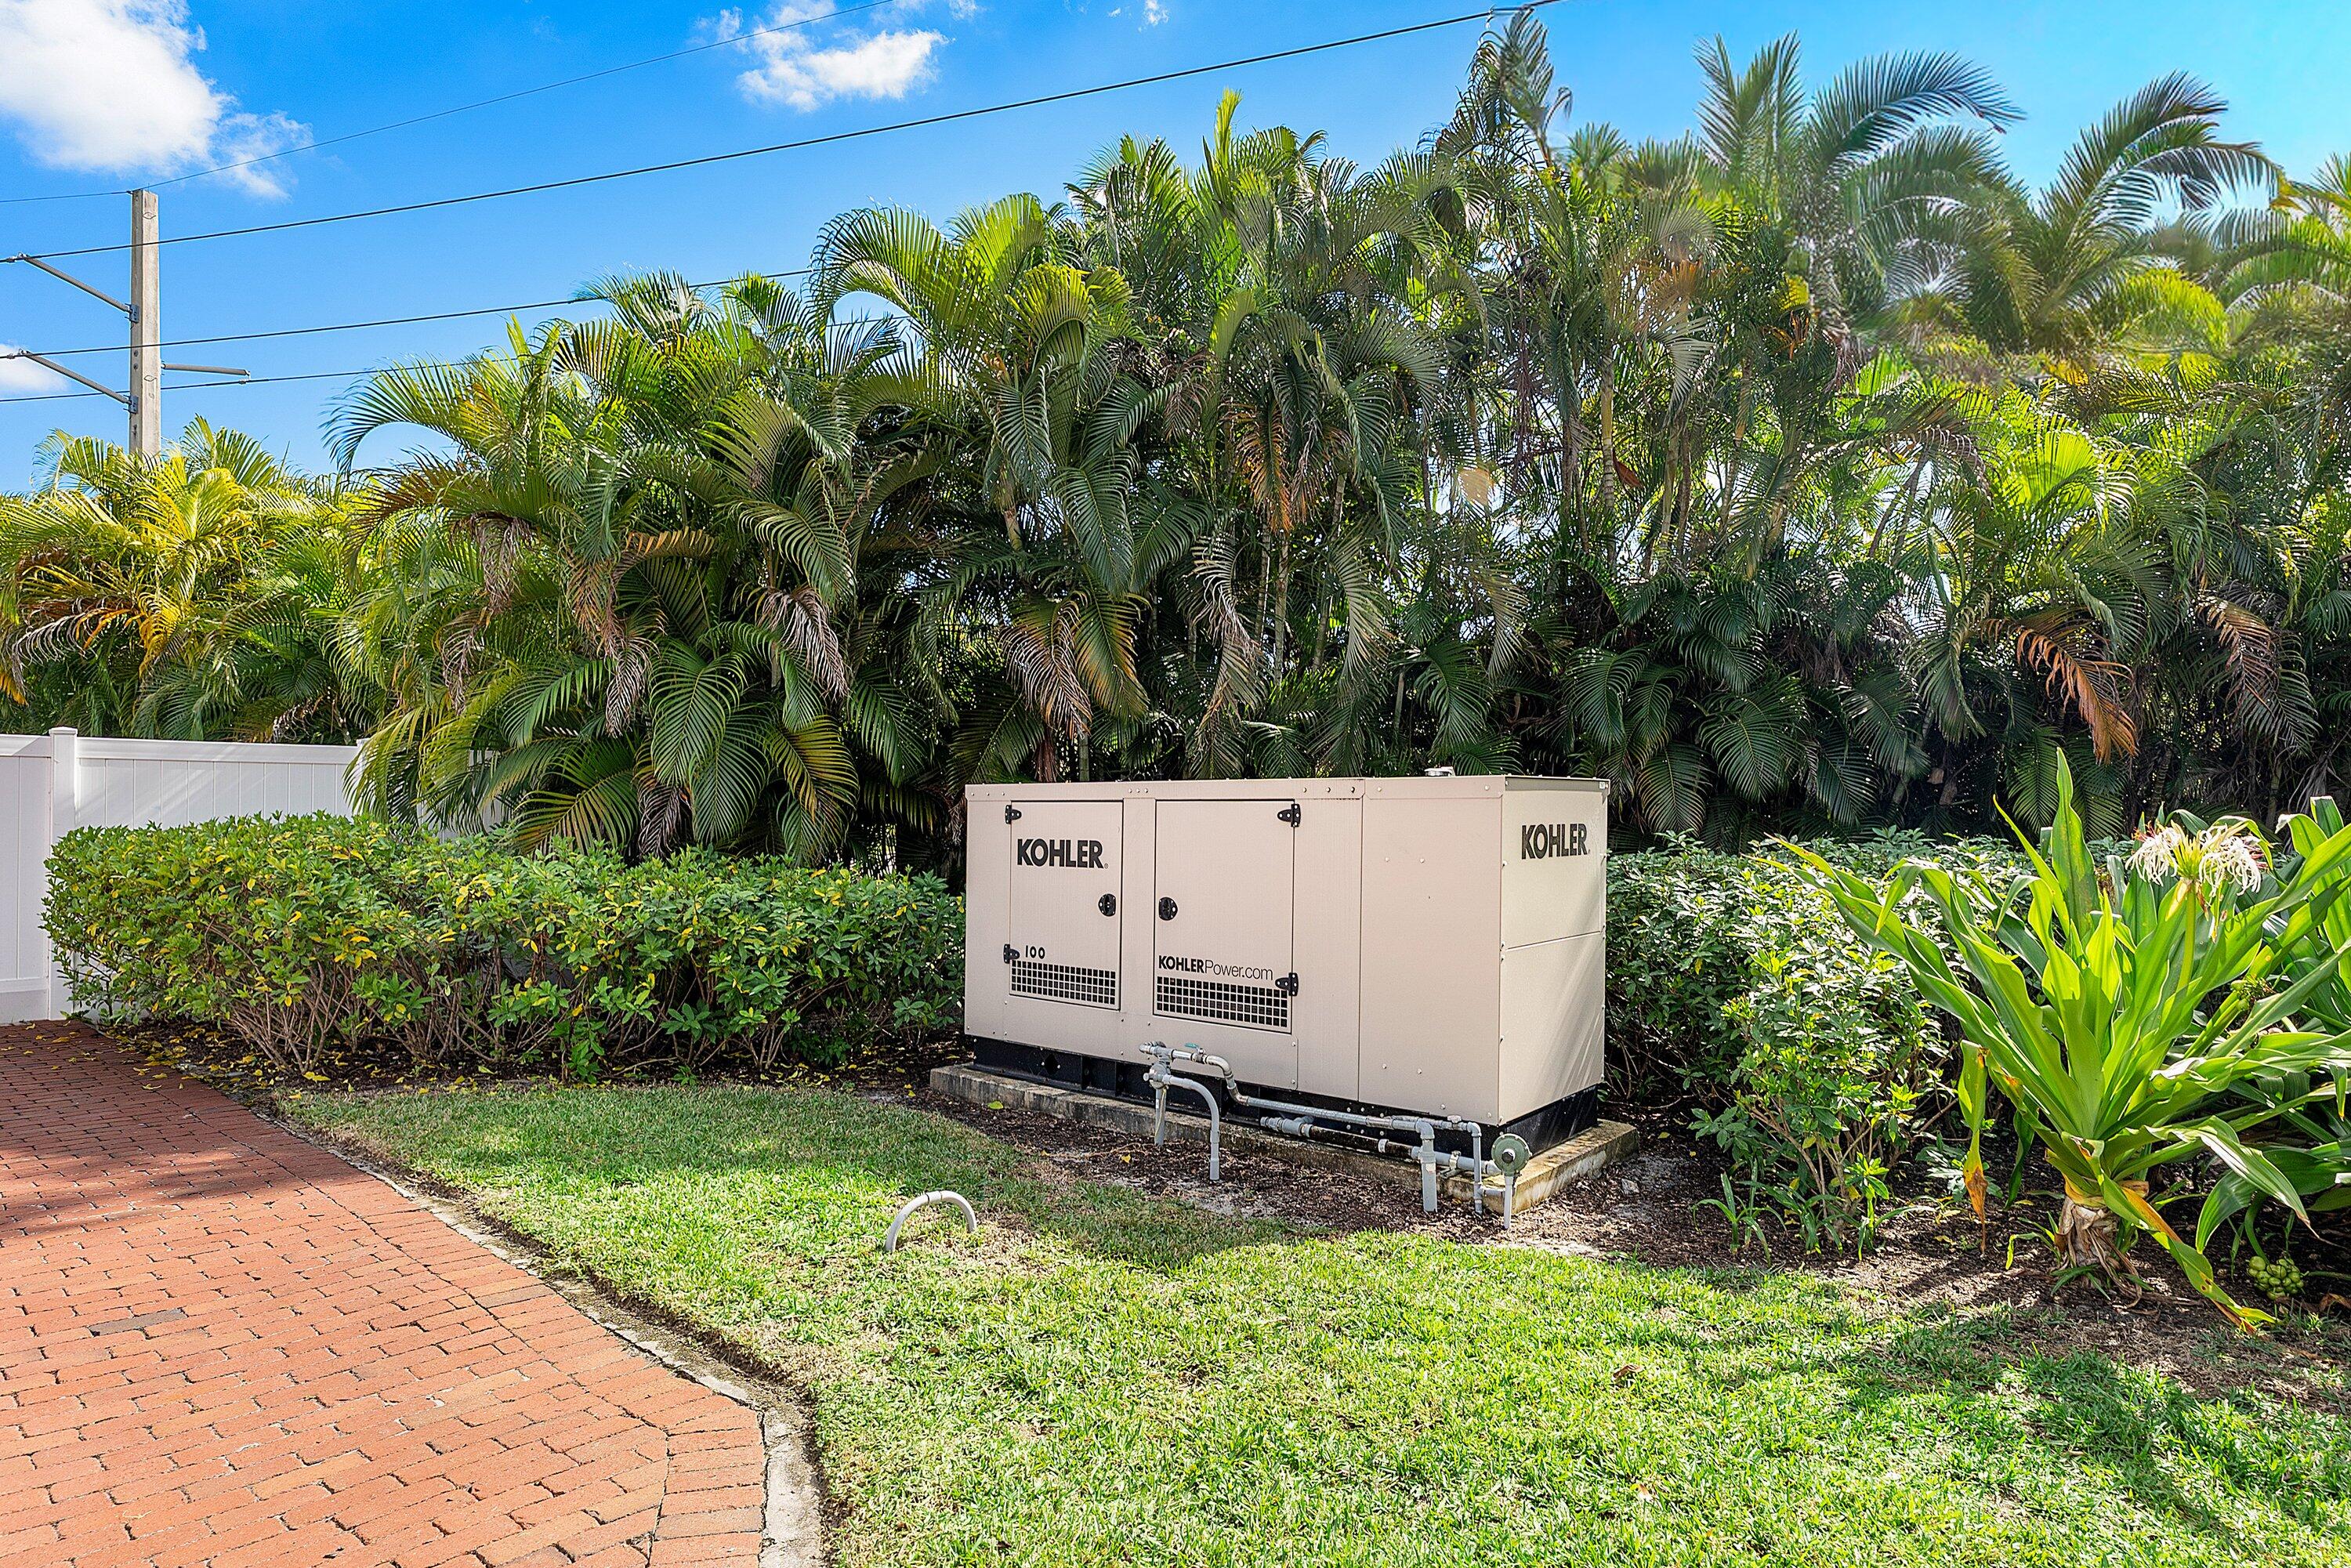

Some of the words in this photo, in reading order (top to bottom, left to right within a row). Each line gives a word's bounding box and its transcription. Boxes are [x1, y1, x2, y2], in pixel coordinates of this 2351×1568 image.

[1017, 838, 1104, 869] KOHLER
[1522, 823, 1588, 860] KOHLER
[1025, 945, 1045, 959] 100
[1158, 955, 1273, 980] KOHLERPower.com
